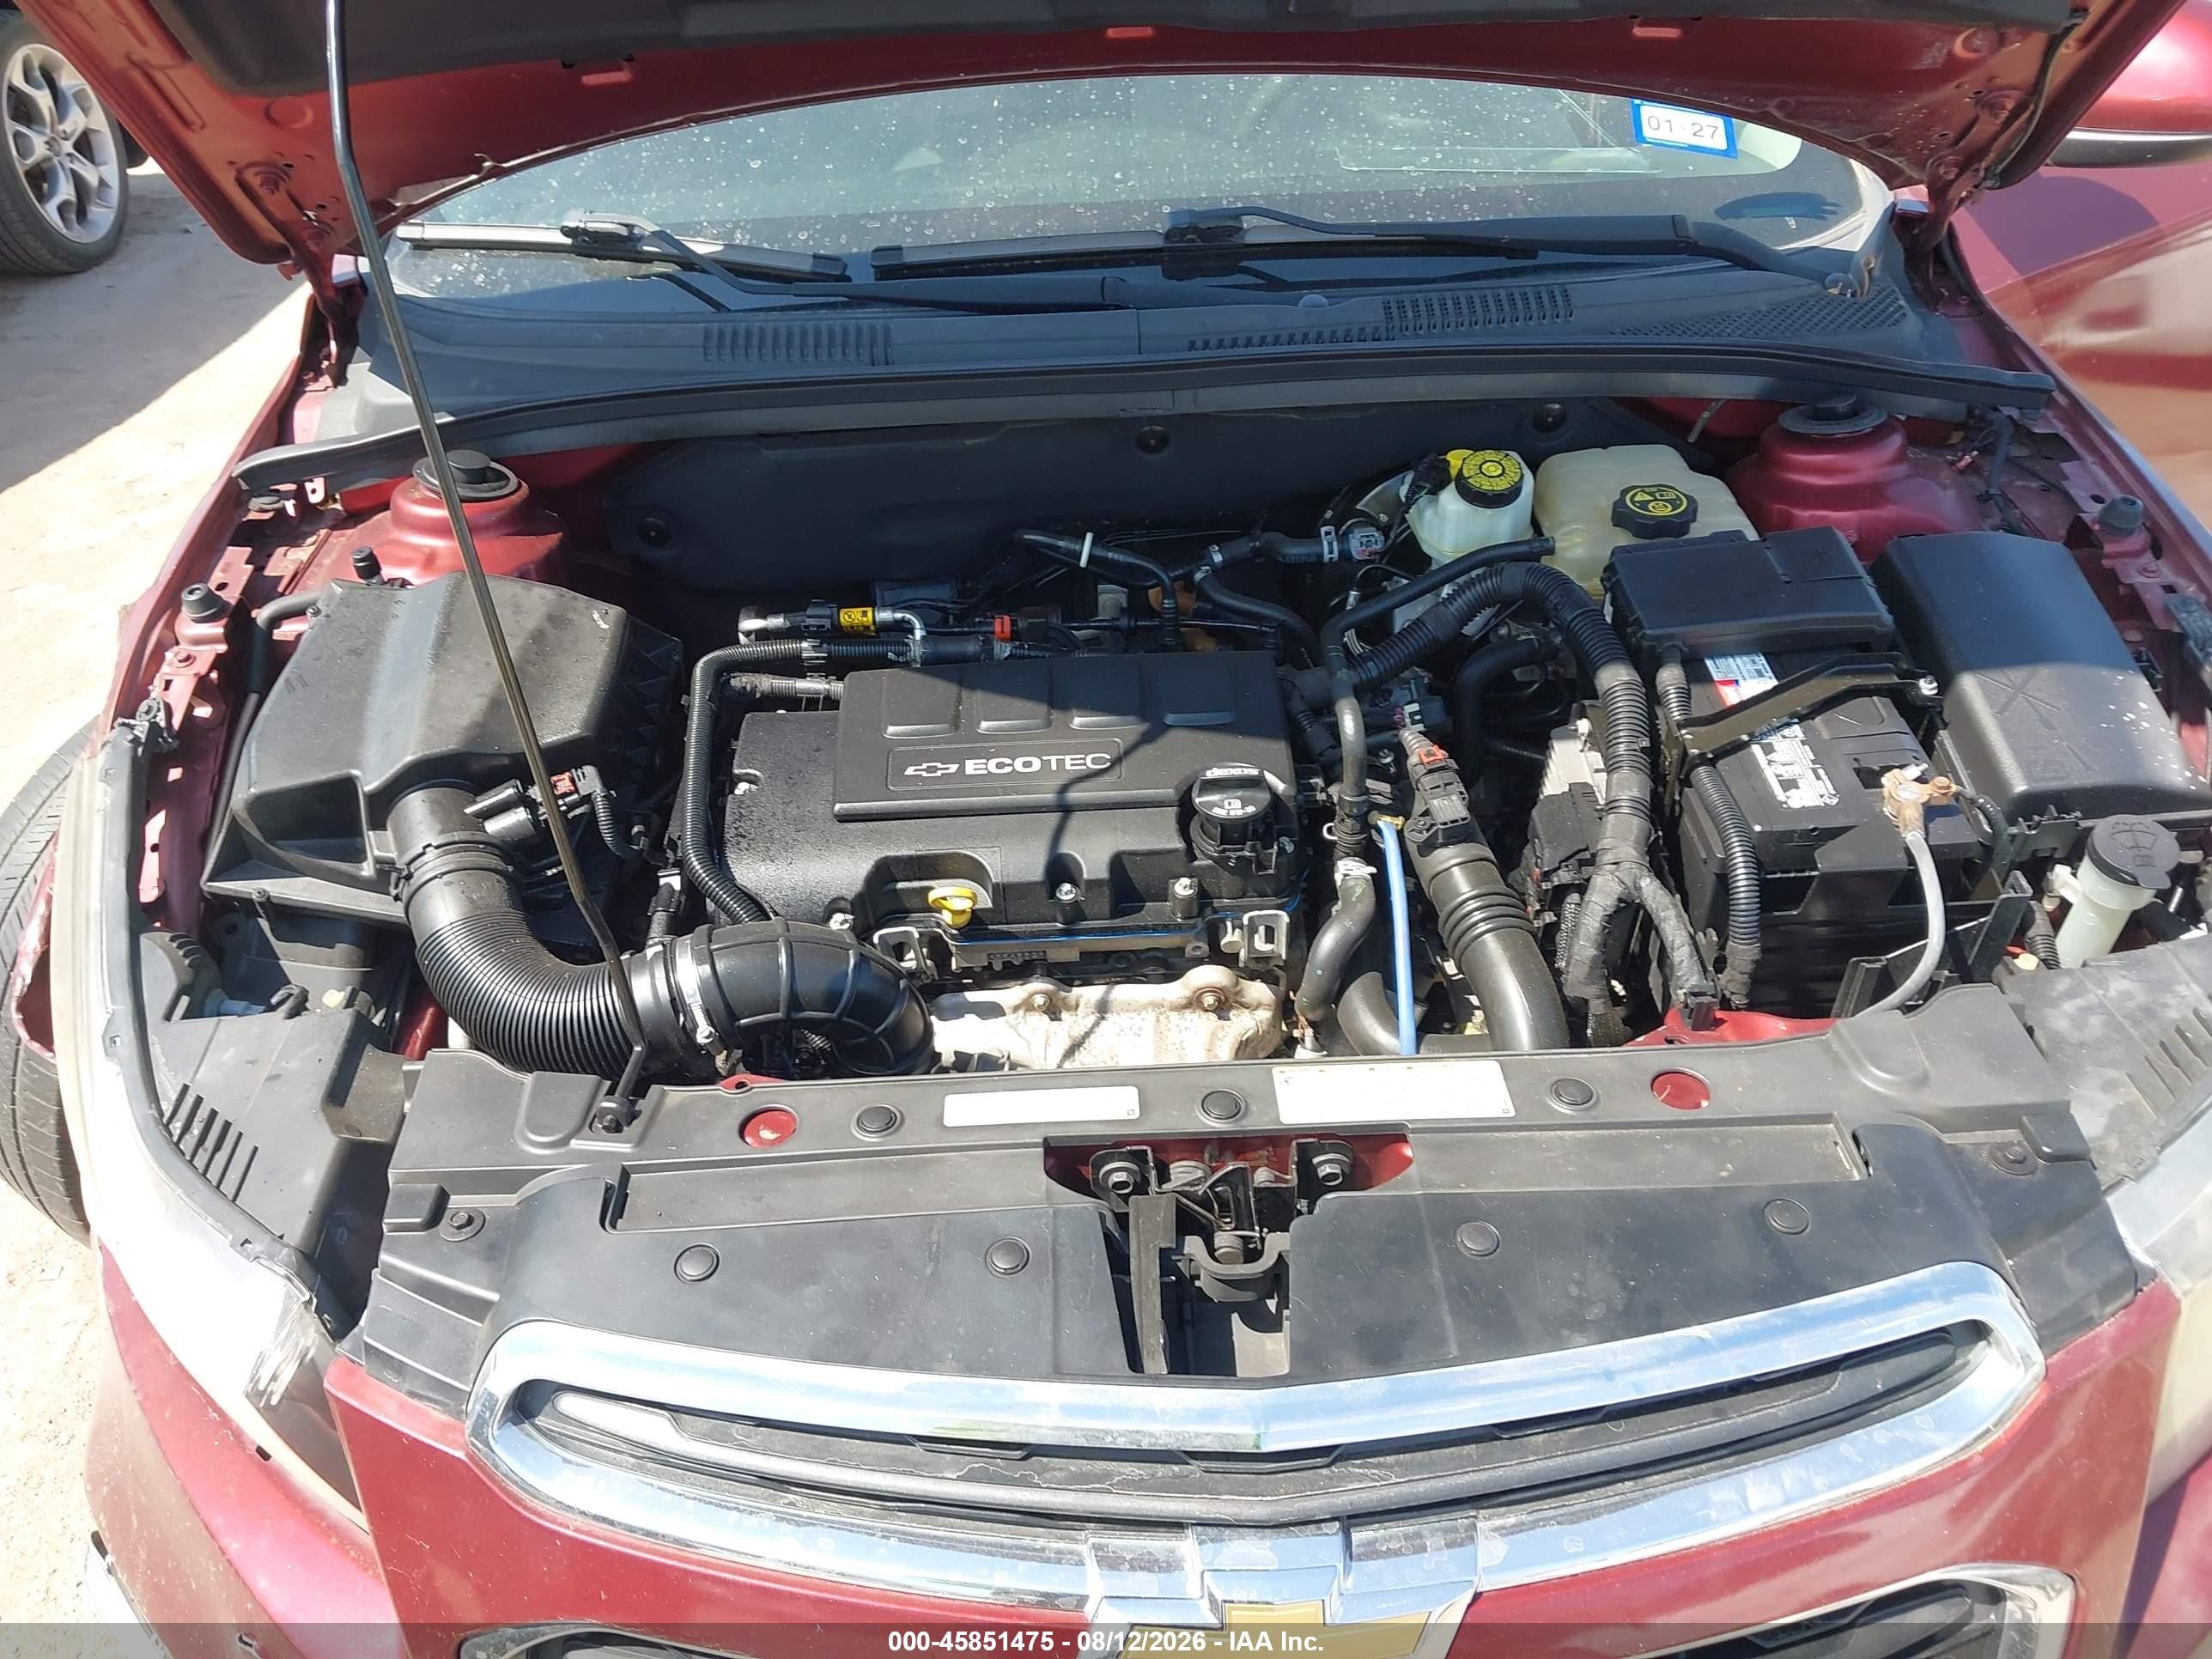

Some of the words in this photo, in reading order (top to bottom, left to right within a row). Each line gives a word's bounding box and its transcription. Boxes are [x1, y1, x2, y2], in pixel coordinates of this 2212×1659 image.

[1647, 115, 1674, 133] 01
[1690, 122, 1719, 140] 27
[964, 752, 1113, 775] ECOTEC
